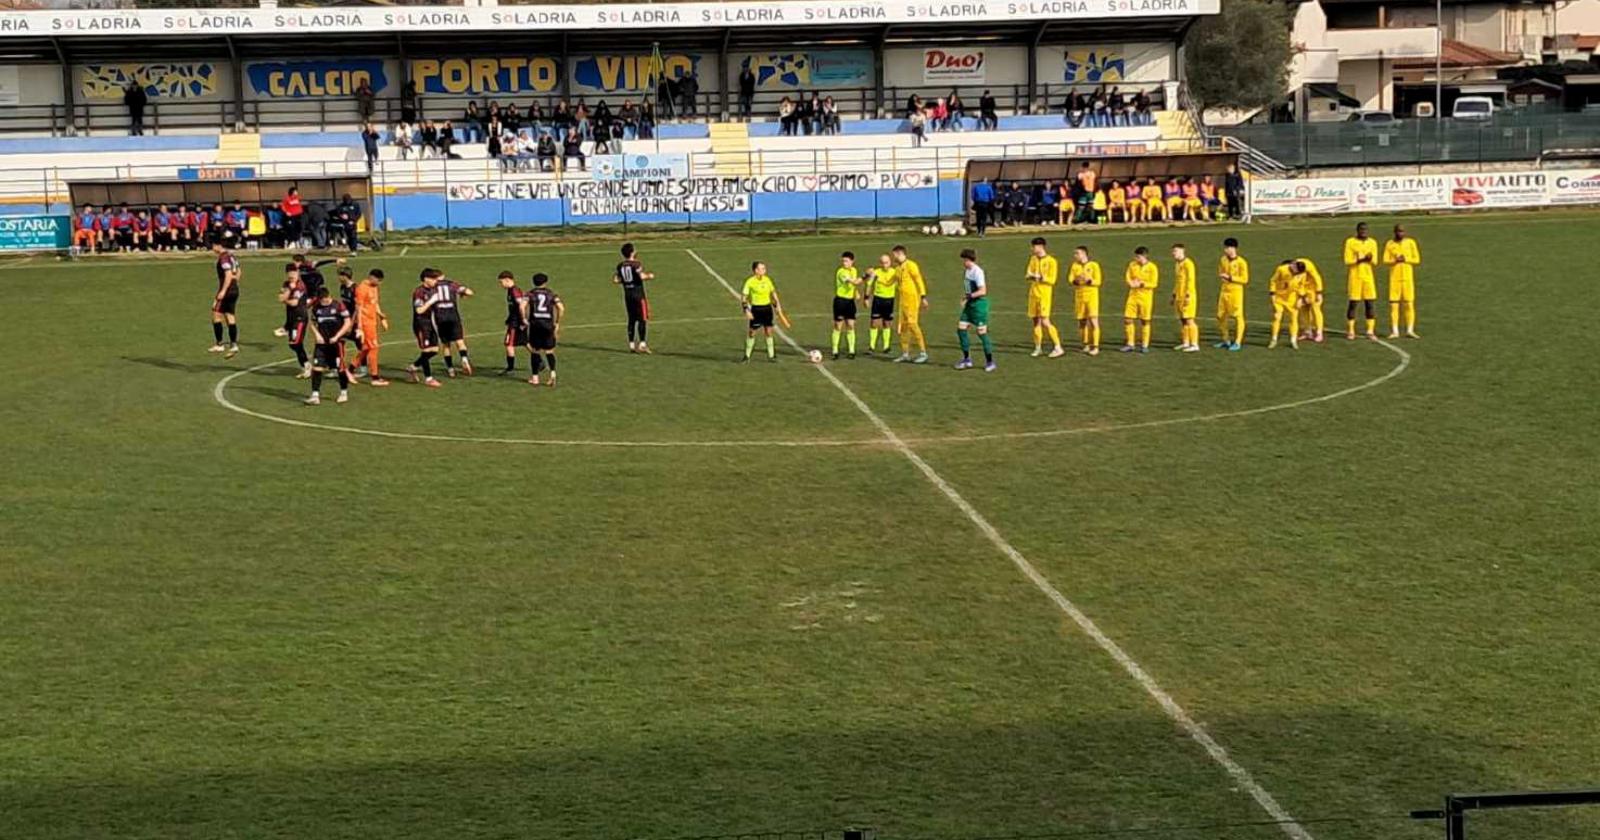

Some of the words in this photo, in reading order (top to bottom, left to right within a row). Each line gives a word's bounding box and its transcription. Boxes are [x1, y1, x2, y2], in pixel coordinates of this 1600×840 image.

[269, 69, 370, 96] CALCIO
[412, 57, 557, 93] PORTO
[614, 168, 671, 178] CAMPIONI
[1455, 174, 1546, 188] VIVIAUTO
[475, 183, 497, 200] SE
[505, 183, 525, 199] NE
[556, 181, 576, 198] UN
[578, 179, 630, 198] GRANDE
[631, 178, 665, 197] UOMO
[678, 177, 720, 195] SUPER
[722, 176, 757, 194] AMICO
[761, 175, 797, 193] CIAO
[818, 173, 869, 191] PRIMO
[1402, 178, 1444, 189] ITALIA
[581, 199, 599, 215] UN
[603, 198, 648, 214] ANGELO
[621, 265, 633, 282] 10
[437, 284, 451, 301] 11
[537, 294, 547, 311] 2
